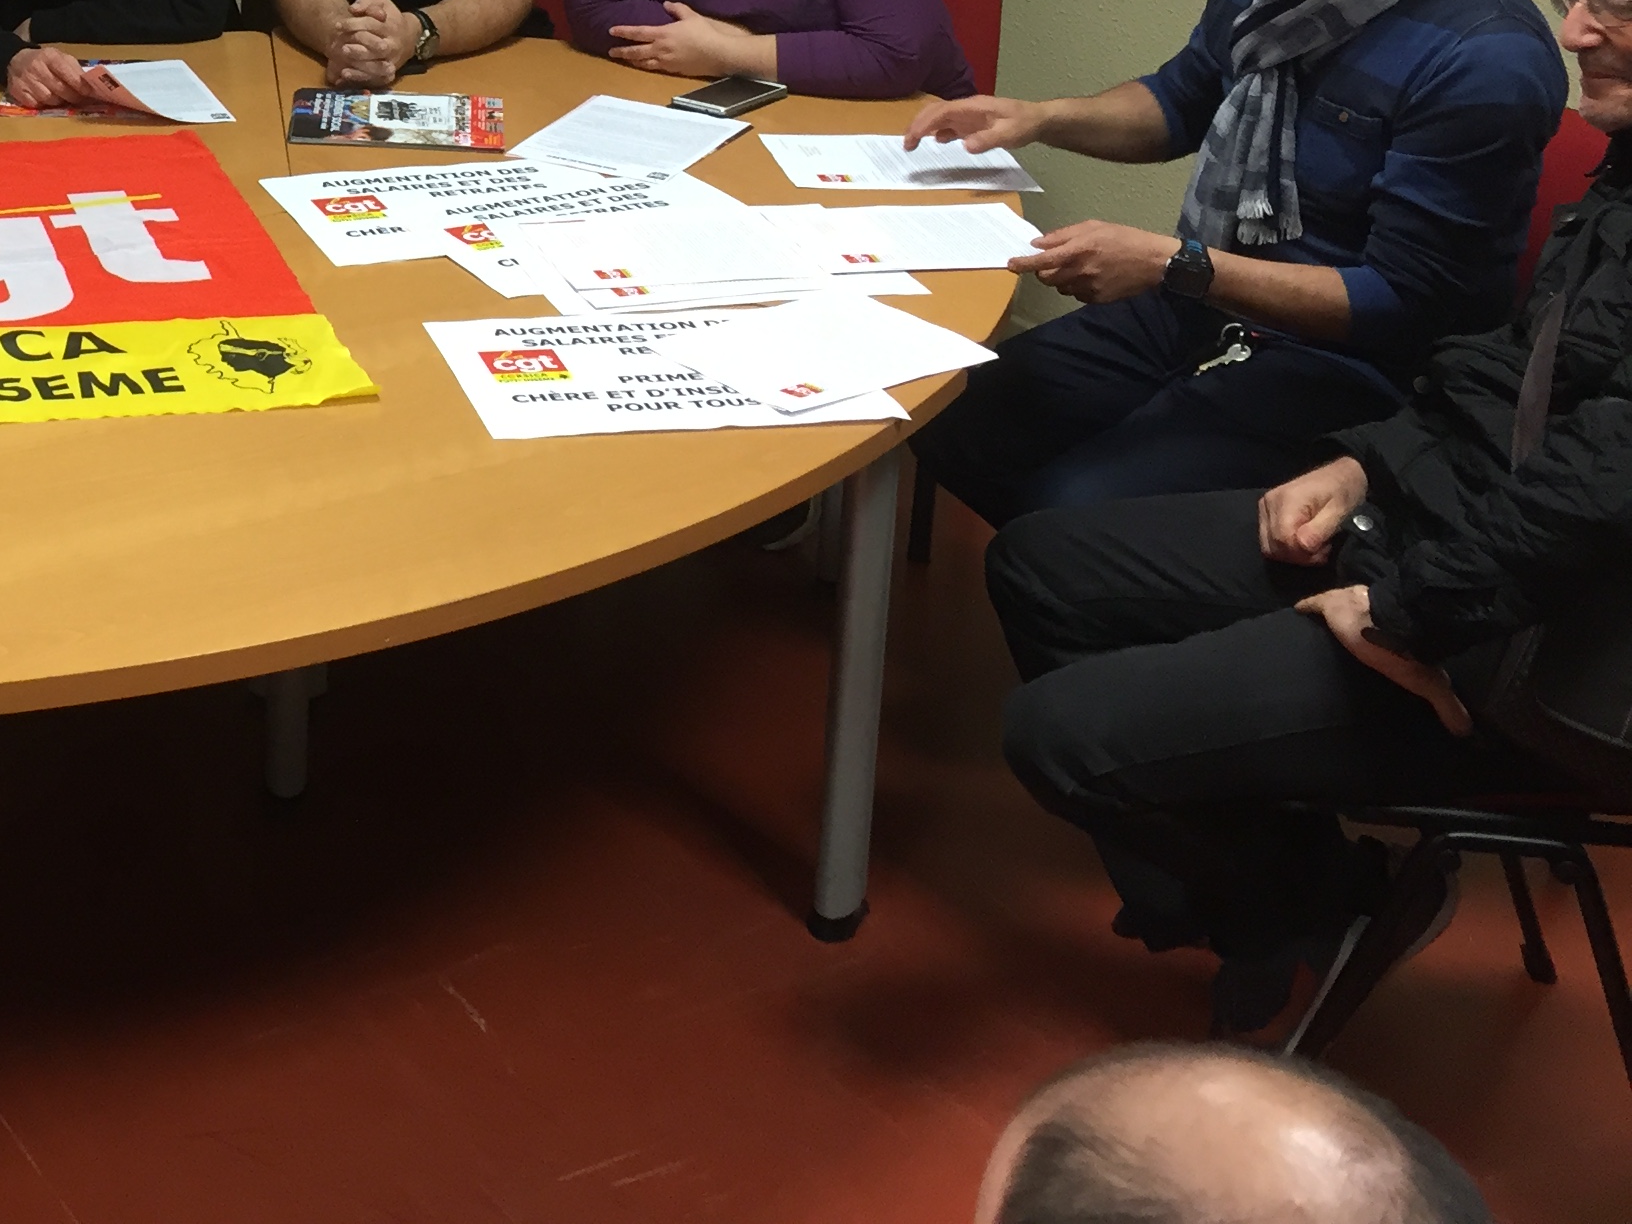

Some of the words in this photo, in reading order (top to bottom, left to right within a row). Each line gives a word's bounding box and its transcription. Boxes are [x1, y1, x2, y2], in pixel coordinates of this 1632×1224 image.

[322, 169, 492, 187] AUGMENTATION
[497, 166, 539, 175] DES
[347, 181, 452, 194] SALAIRES
[457, 179, 481, 187] ET
[489, 175, 531, 184] DES
[325, 198, 380, 213] cgt
[445, 187, 607, 216] AUGMENTATION
[609, 182, 650, 192] DES
[473, 203, 575, 221] SALAIRES
[578, 198, 602, 207] ET
[608, 192, 648, 202] DES
[556, 200, 669, 216] TRAITES
[345, 225, 408, 237] CHÈR
[495, 321, 697, 336] AUGMENTATION
[522, 334, 648, 347] SALAIRES
[493, 355, 558, 373] cgt
[618, 373, 704, 383] PRIME
[512, 390, 599, 403] CHÈRE
[606, 390, 635, 399] ET
[607, 401, 683, 412] POUR
[688, 398, 761, 408] TOUS
